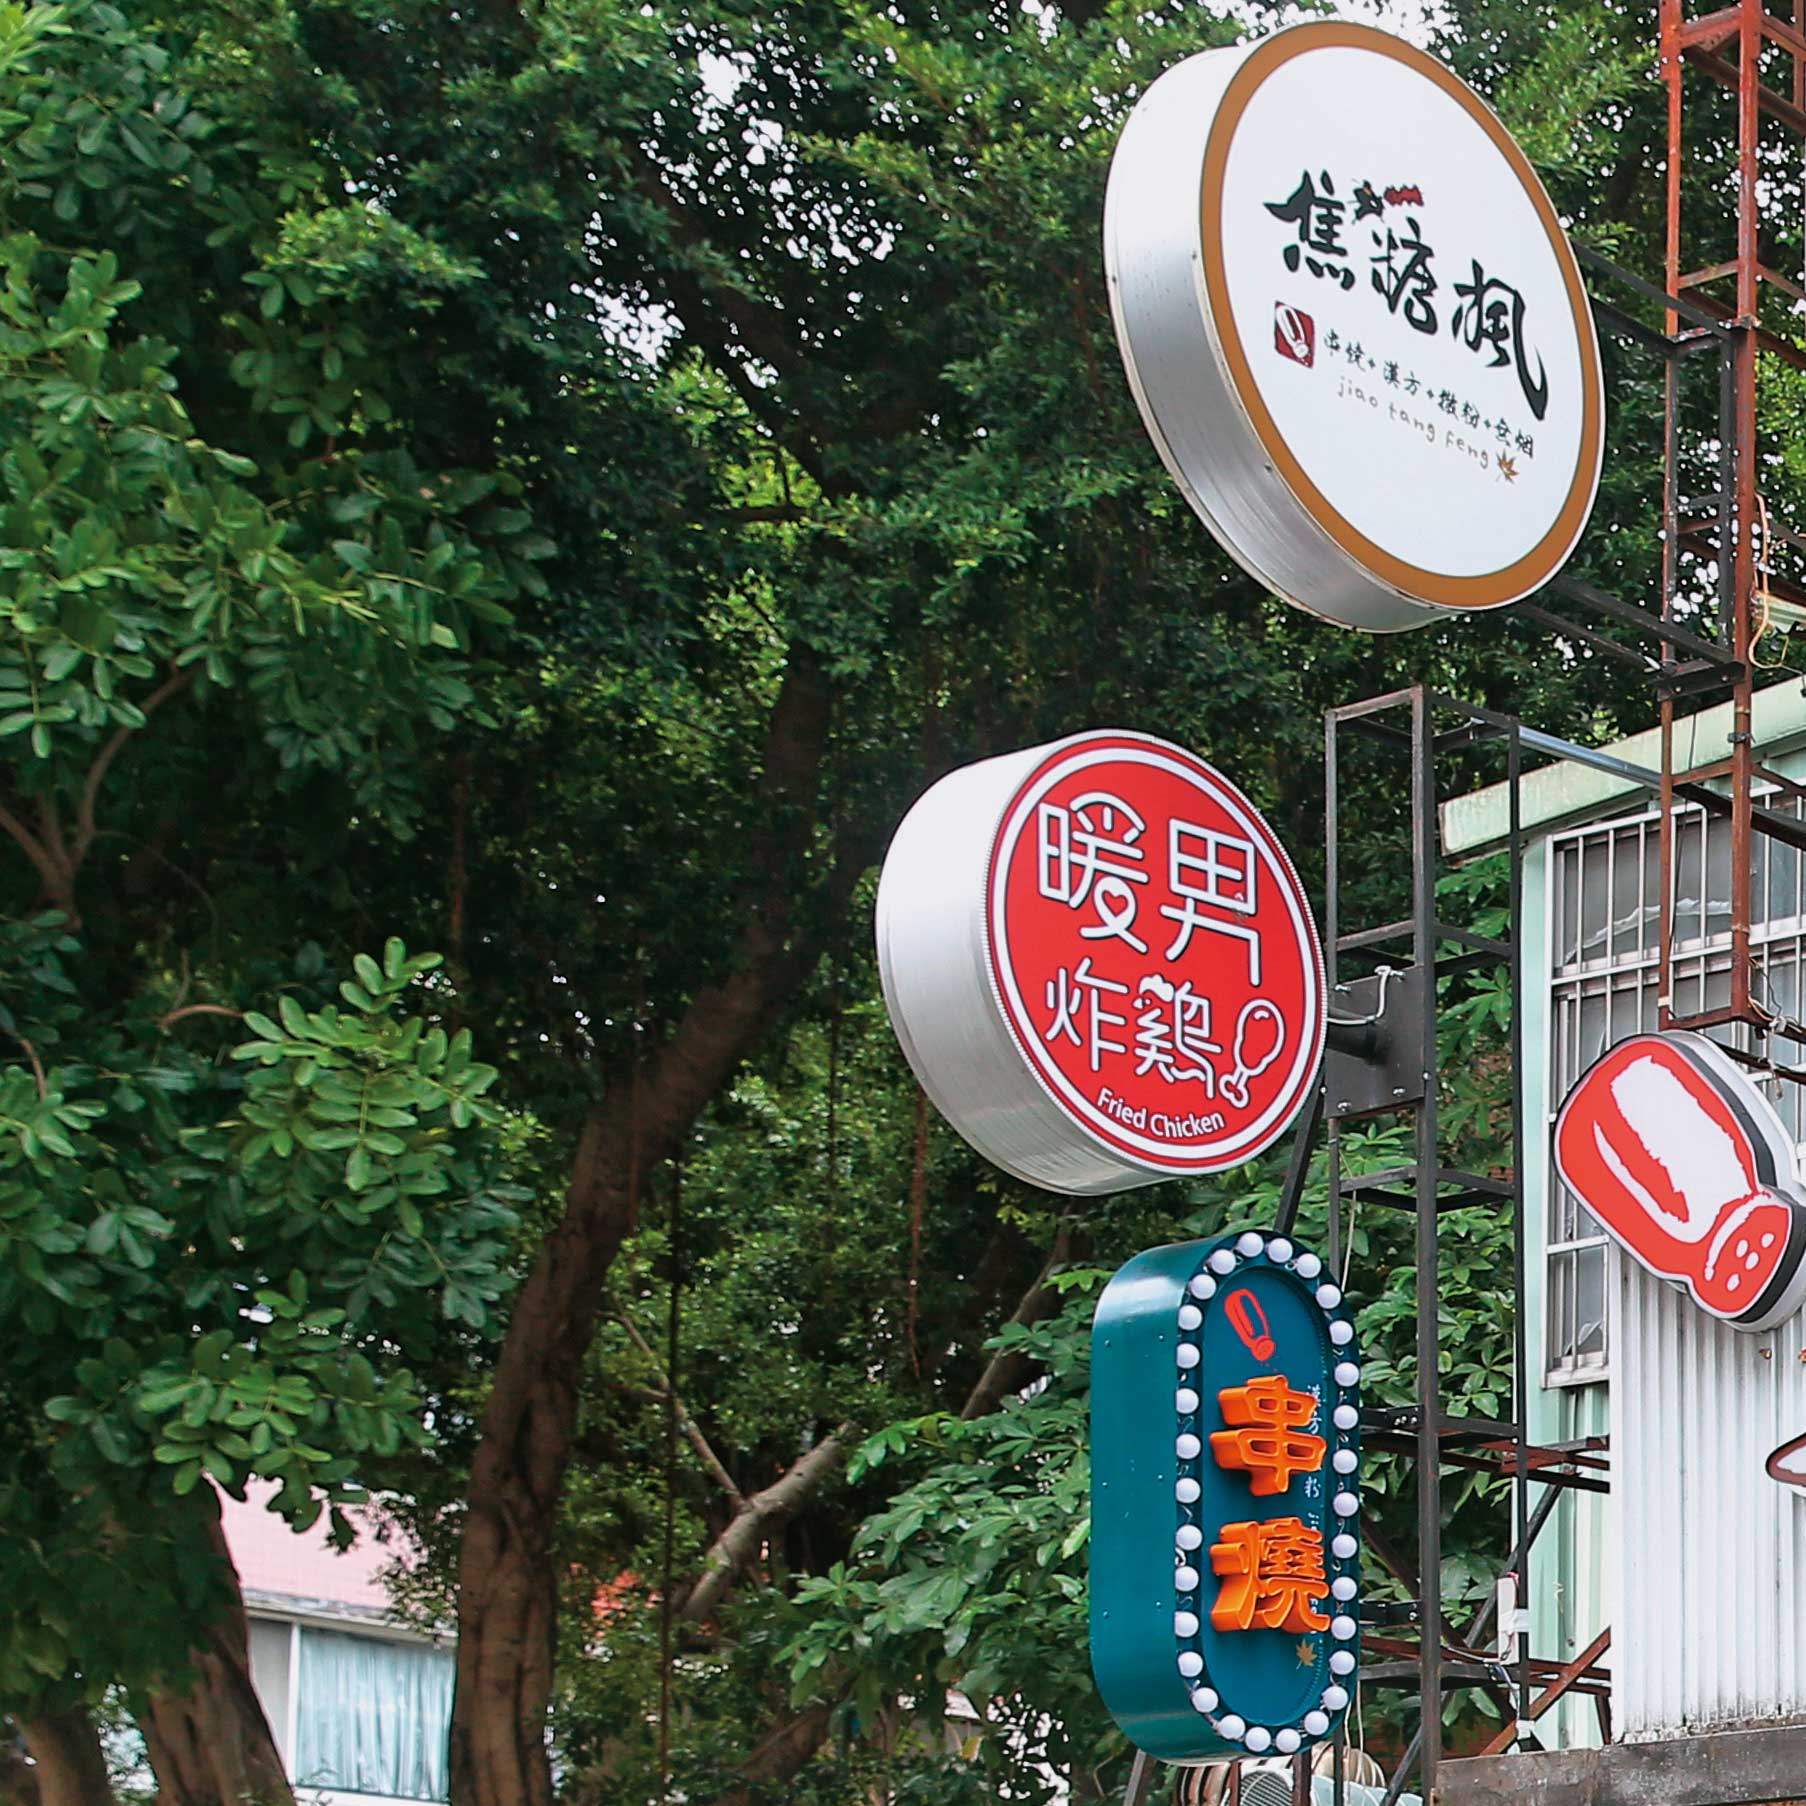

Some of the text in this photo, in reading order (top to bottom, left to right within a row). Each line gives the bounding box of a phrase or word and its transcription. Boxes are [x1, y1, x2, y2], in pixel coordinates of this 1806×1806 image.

[1263, 170, 1548, 421] 焦糖楓
[1337, 376, 1489, 469] jiao tang feng
[1037, 791, 1260, 986] 暖男
[1096, 1087, 1226, 1140] Fried Chicken
